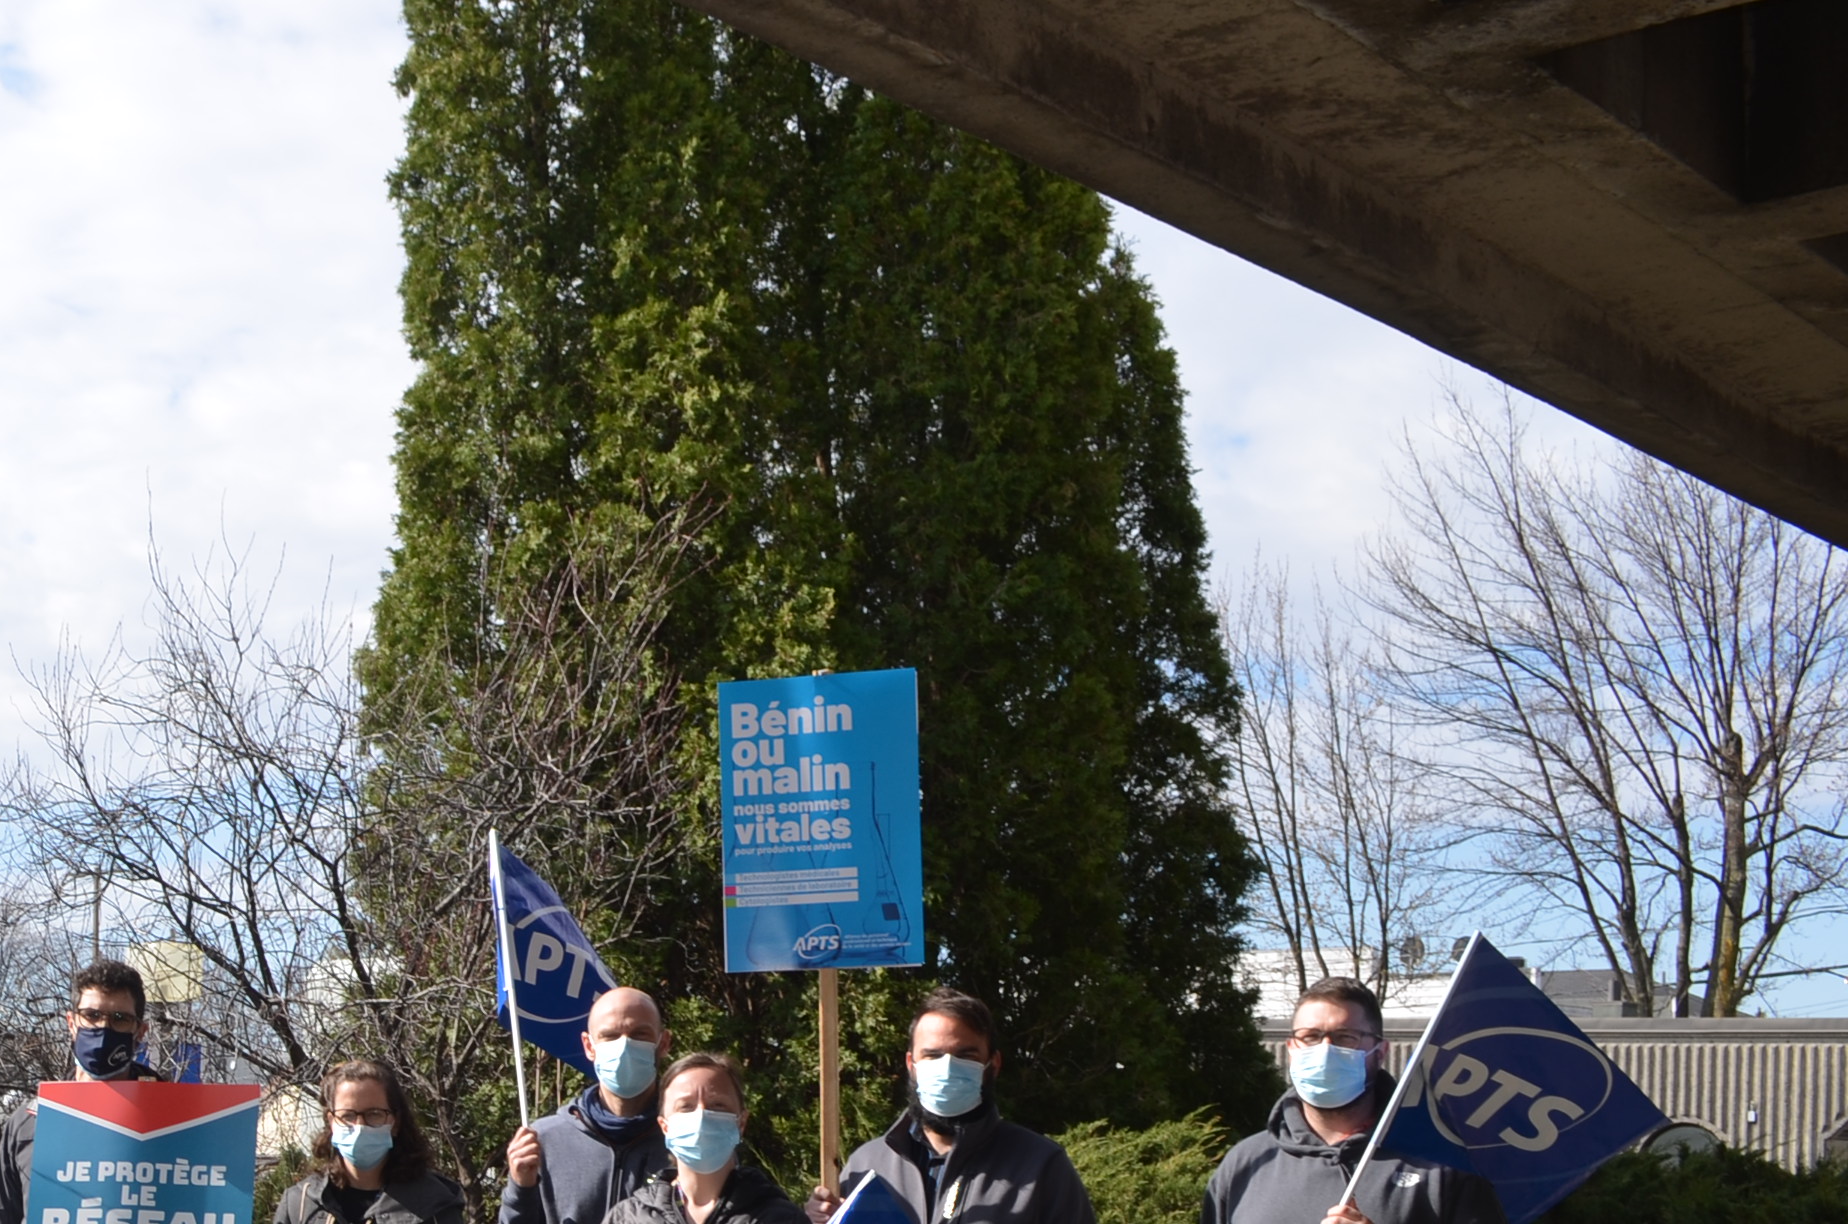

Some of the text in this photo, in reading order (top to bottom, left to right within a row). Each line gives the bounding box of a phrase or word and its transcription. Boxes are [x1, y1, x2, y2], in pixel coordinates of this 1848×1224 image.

[731, 695, 853, 739] Bénin
[732, 738, 785, 768] ou
[733, 754, 851, 796] malin
[734, 798, 850, 816] nous sommes
[735, 813, 852, 845] vitales
[735, 842, 852, 857] pour produire vos analyses
[793, 935, 840, 951] APTS
[56, 1157, 227, 1187] JE PROTÈGE
[120, 1184, 157, 1207] LE
